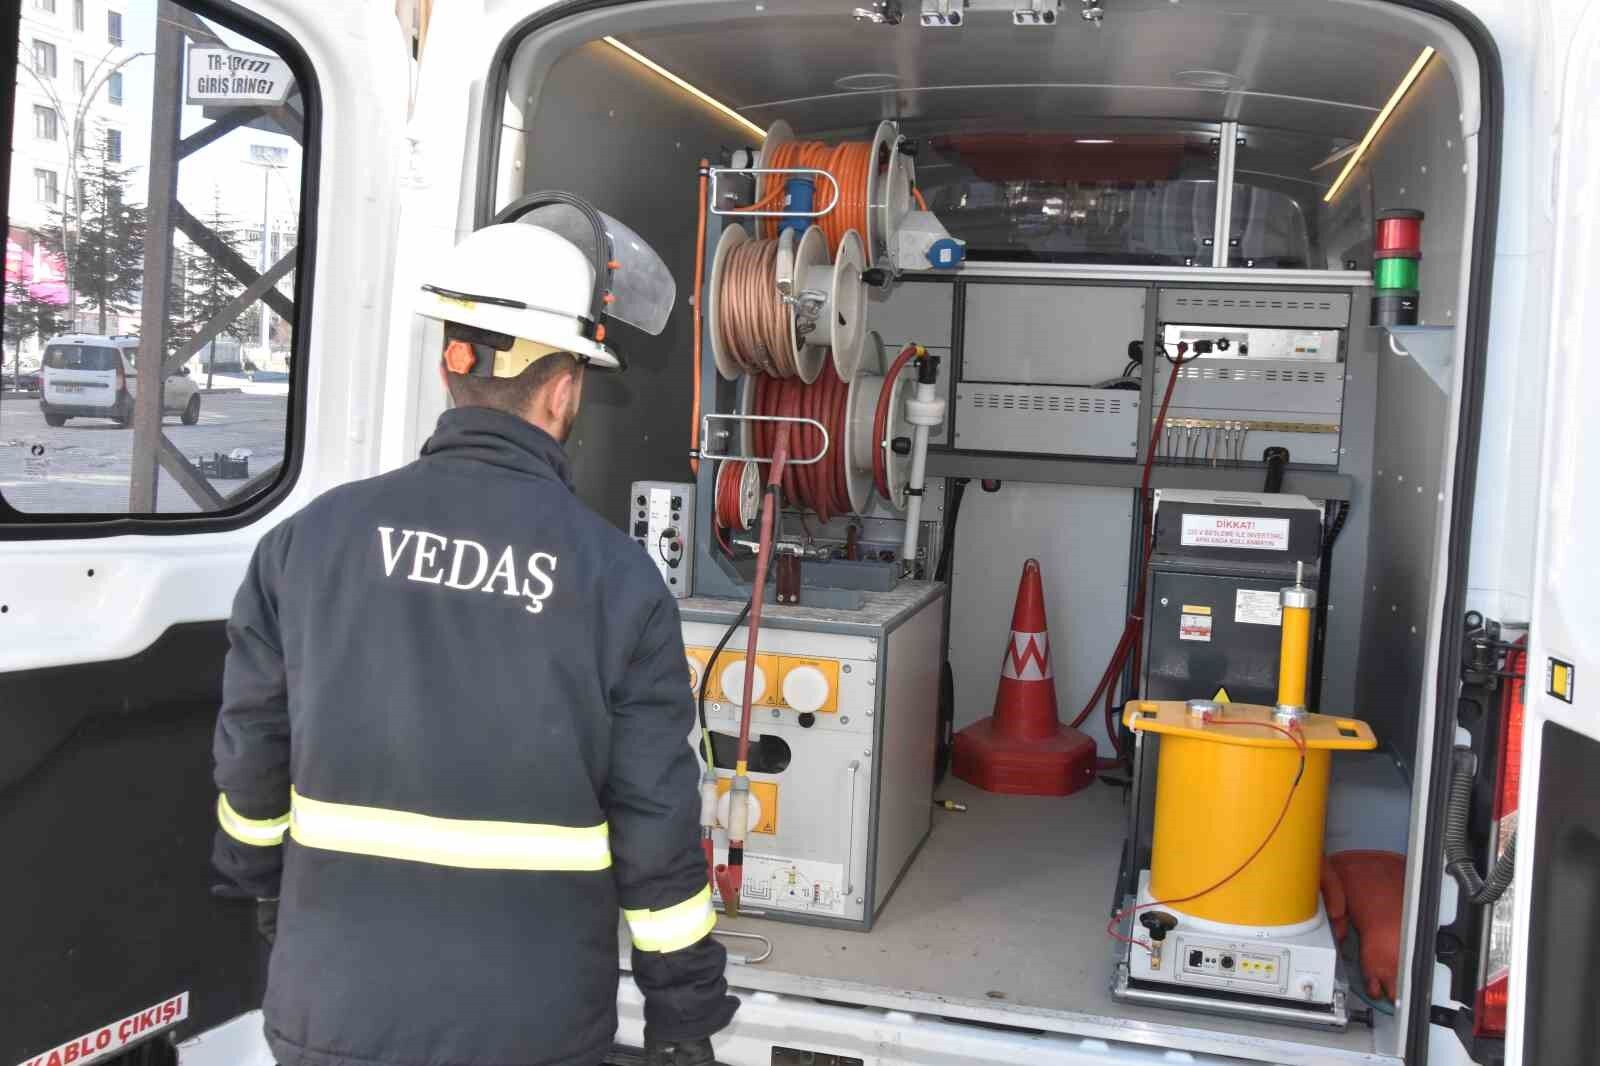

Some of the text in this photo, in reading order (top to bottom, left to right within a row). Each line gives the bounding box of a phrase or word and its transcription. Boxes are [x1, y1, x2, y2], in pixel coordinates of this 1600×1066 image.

[198, 74, 229, 96] GİRİŞ
[1216, 519, 1255, 529] DİKKAT!
[377, 526, 557, 614] VEDAŞ
[119, 996, 182, 1044] ÇIKIŞI
